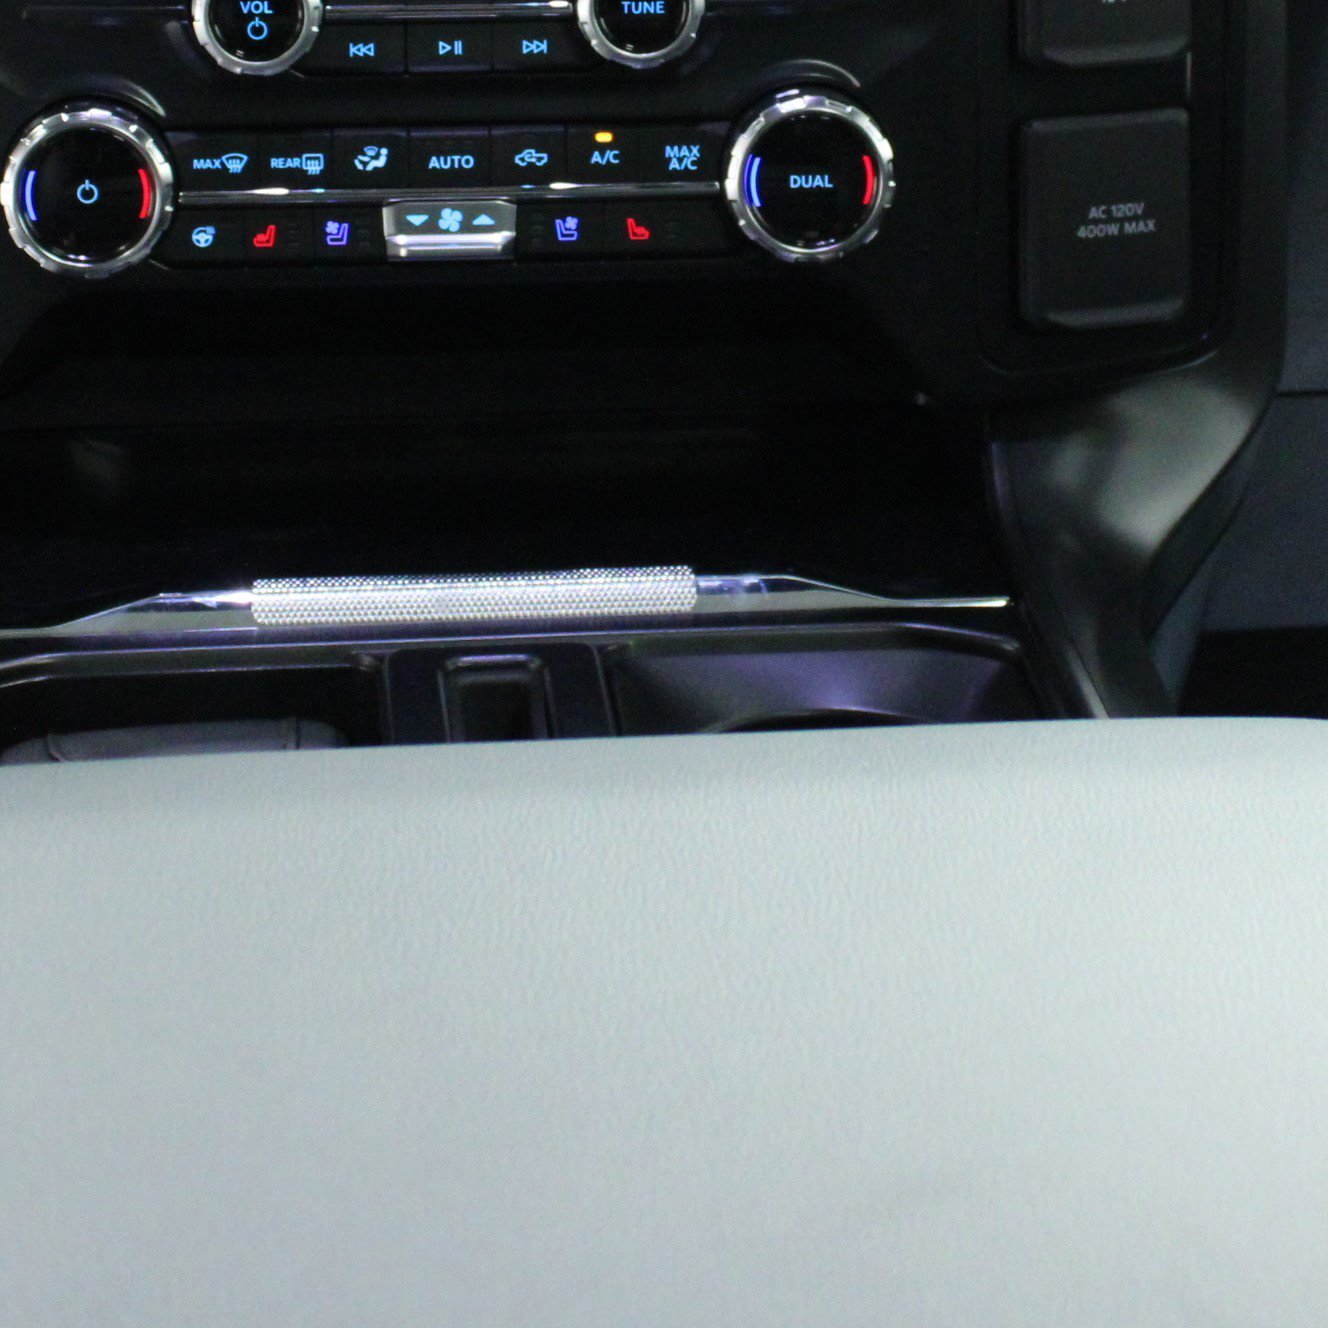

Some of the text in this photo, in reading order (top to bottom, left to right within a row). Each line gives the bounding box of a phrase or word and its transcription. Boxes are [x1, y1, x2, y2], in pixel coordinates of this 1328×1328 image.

[239, 0, 274, 15] VOL
[621, 0, 665, 15] TUNE
[590, 149, 620, 165] A/C
[664, 145, 701, 158] MAX
[192, 156, 223, 170] MAX
[270, 156, 300, 170] REAR
[428, 154, 475, 170] AUTO
[668, 157, 698, 171] A/C
[789, 174, 834, 189] DUAL
[1088, 202, 1145, 219] AC 120V
[1077, 219, 1156, 239] 400W MAX
